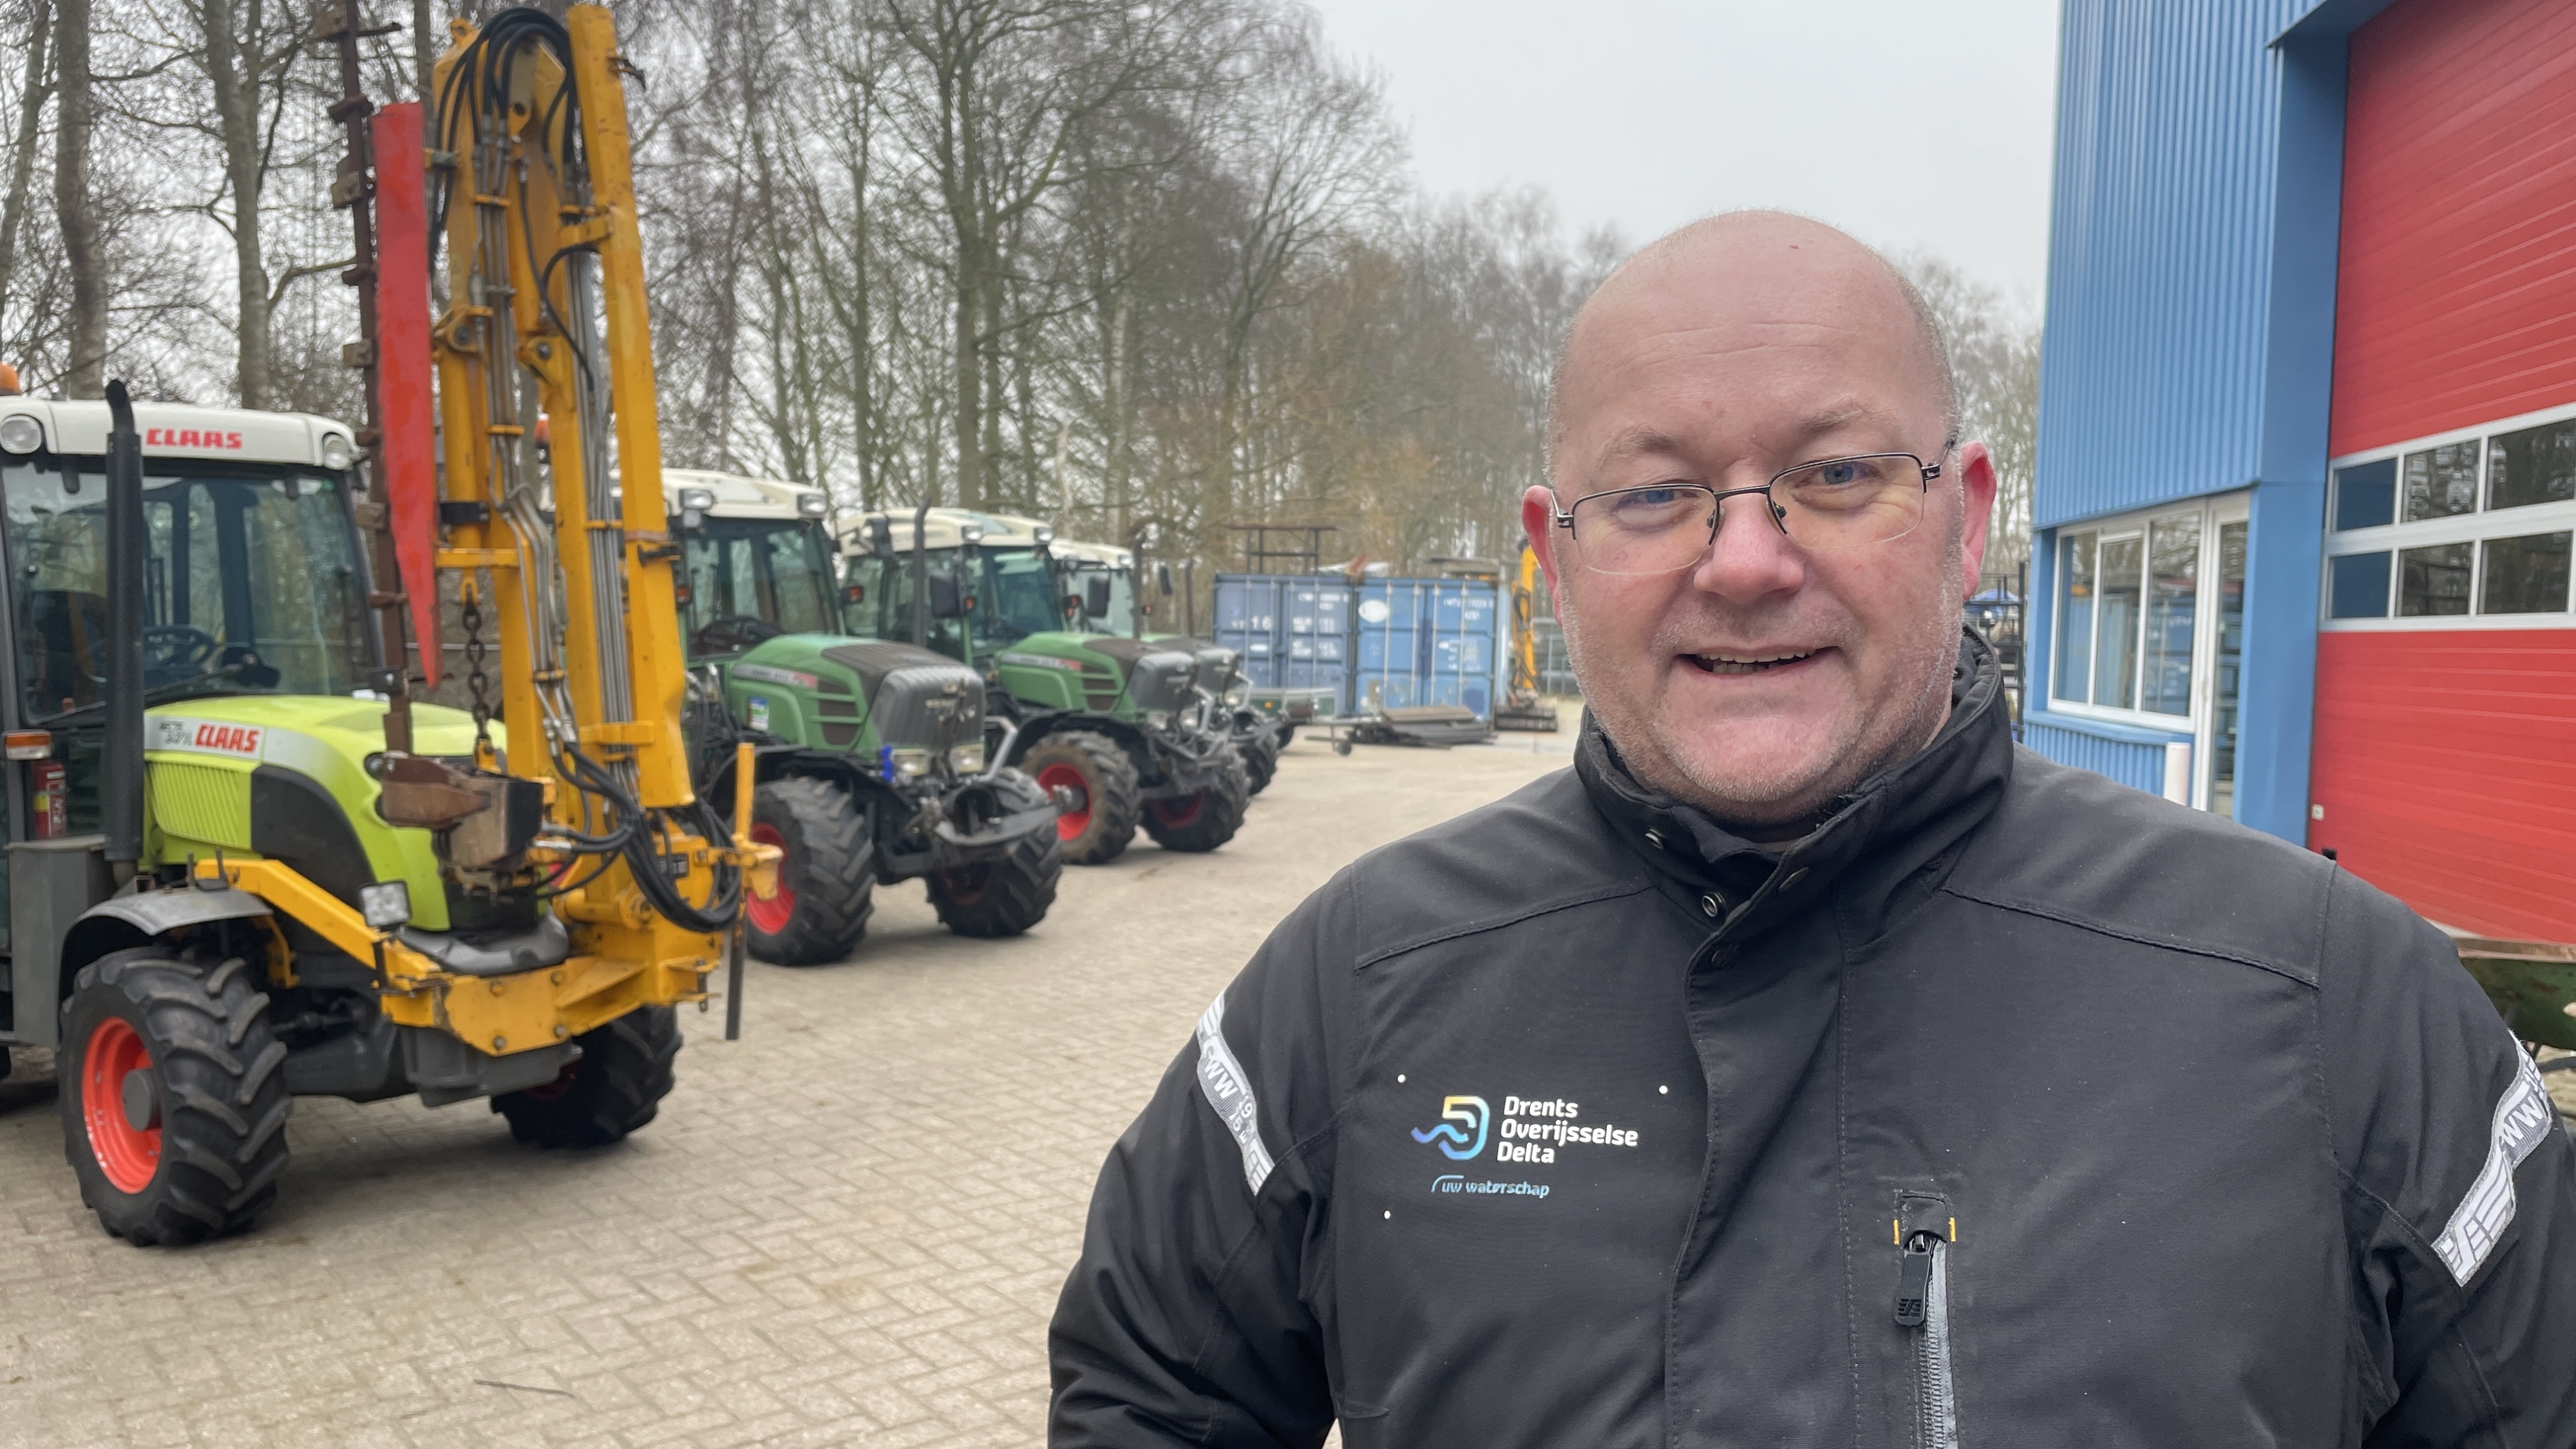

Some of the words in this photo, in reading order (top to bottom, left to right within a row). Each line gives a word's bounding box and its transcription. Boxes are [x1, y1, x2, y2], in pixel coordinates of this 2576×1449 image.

[146, 428, 243, 450] CLAAS
[195, 723, 260, 753] CLAAS
[1503, 1095, 1578, 1118] Drents
[1501, 1118, 1638, 1147] Overijsselse
[1497, 1141, 1555, 1164] Delta
[1441, 1181, 1463, 1193] uw
[1465, 1180, 1550, 1199] waterschap
